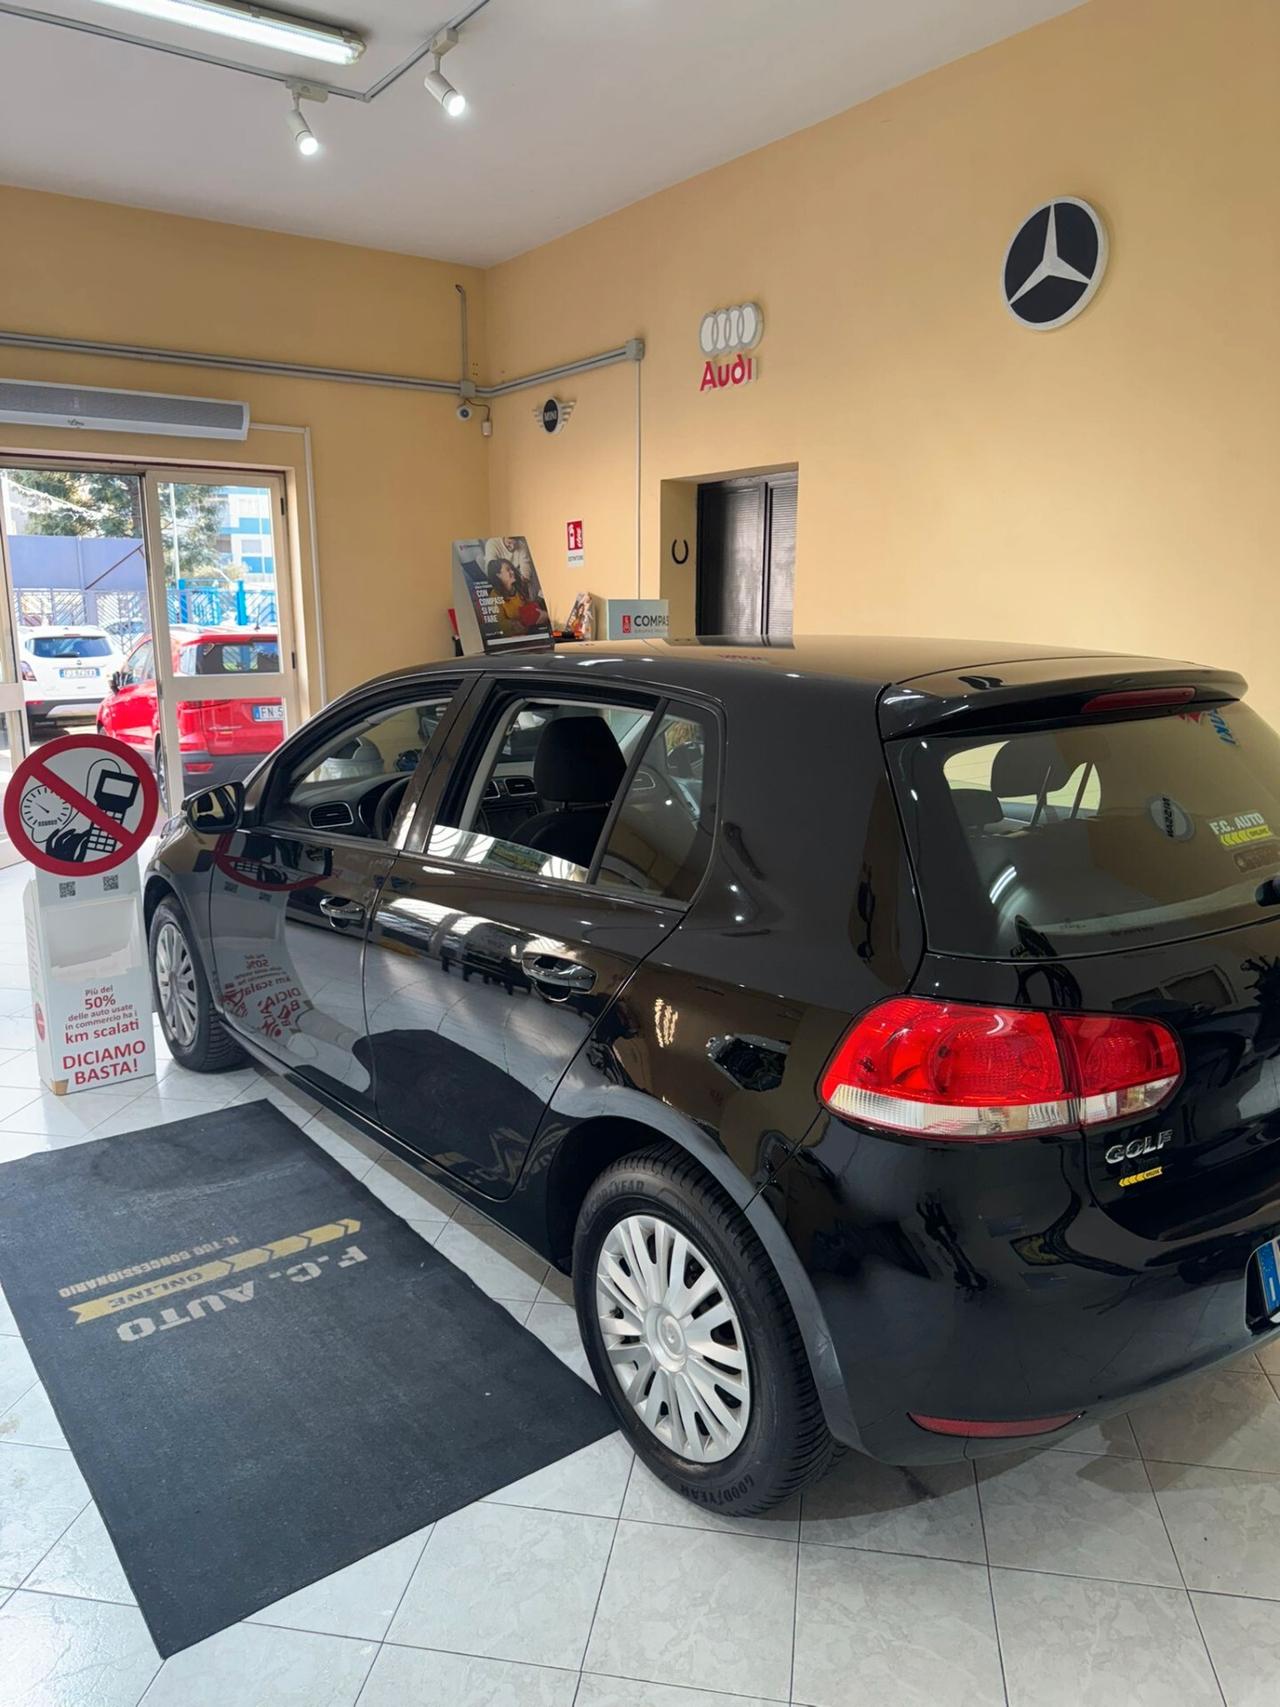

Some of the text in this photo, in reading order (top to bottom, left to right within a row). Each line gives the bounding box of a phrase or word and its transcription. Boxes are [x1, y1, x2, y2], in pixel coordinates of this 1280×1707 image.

[700, 353, 753, 391] Audi
[1233, 812, 1265, 830] AUTO
[84, 994, 116, 1010] 50%
[100, 985, 113, 994] del
[65, 1023, 74, 1031] in
[75, 1014, 121, 1029] commercio
[68, 1003, 133, 1022] delle auto usate
[65, 1018, 140, 1045] km scalati
[62, 1039, 146, 1070] DICIAMO
[74, 1057, 139, 1085] BASTA!
[1105, 1129, 1173, 1164] GOLF
[192, 1241, 224, 1256] TUO
[58, 1250, 192, 1298] CONCESSIONARIO
[109, 1271, 204, 1309] ONLINE
[116, 1245, 368, 1342] F.C. AUTO
[681, 1473, 755, 1506] GOODYEAR
